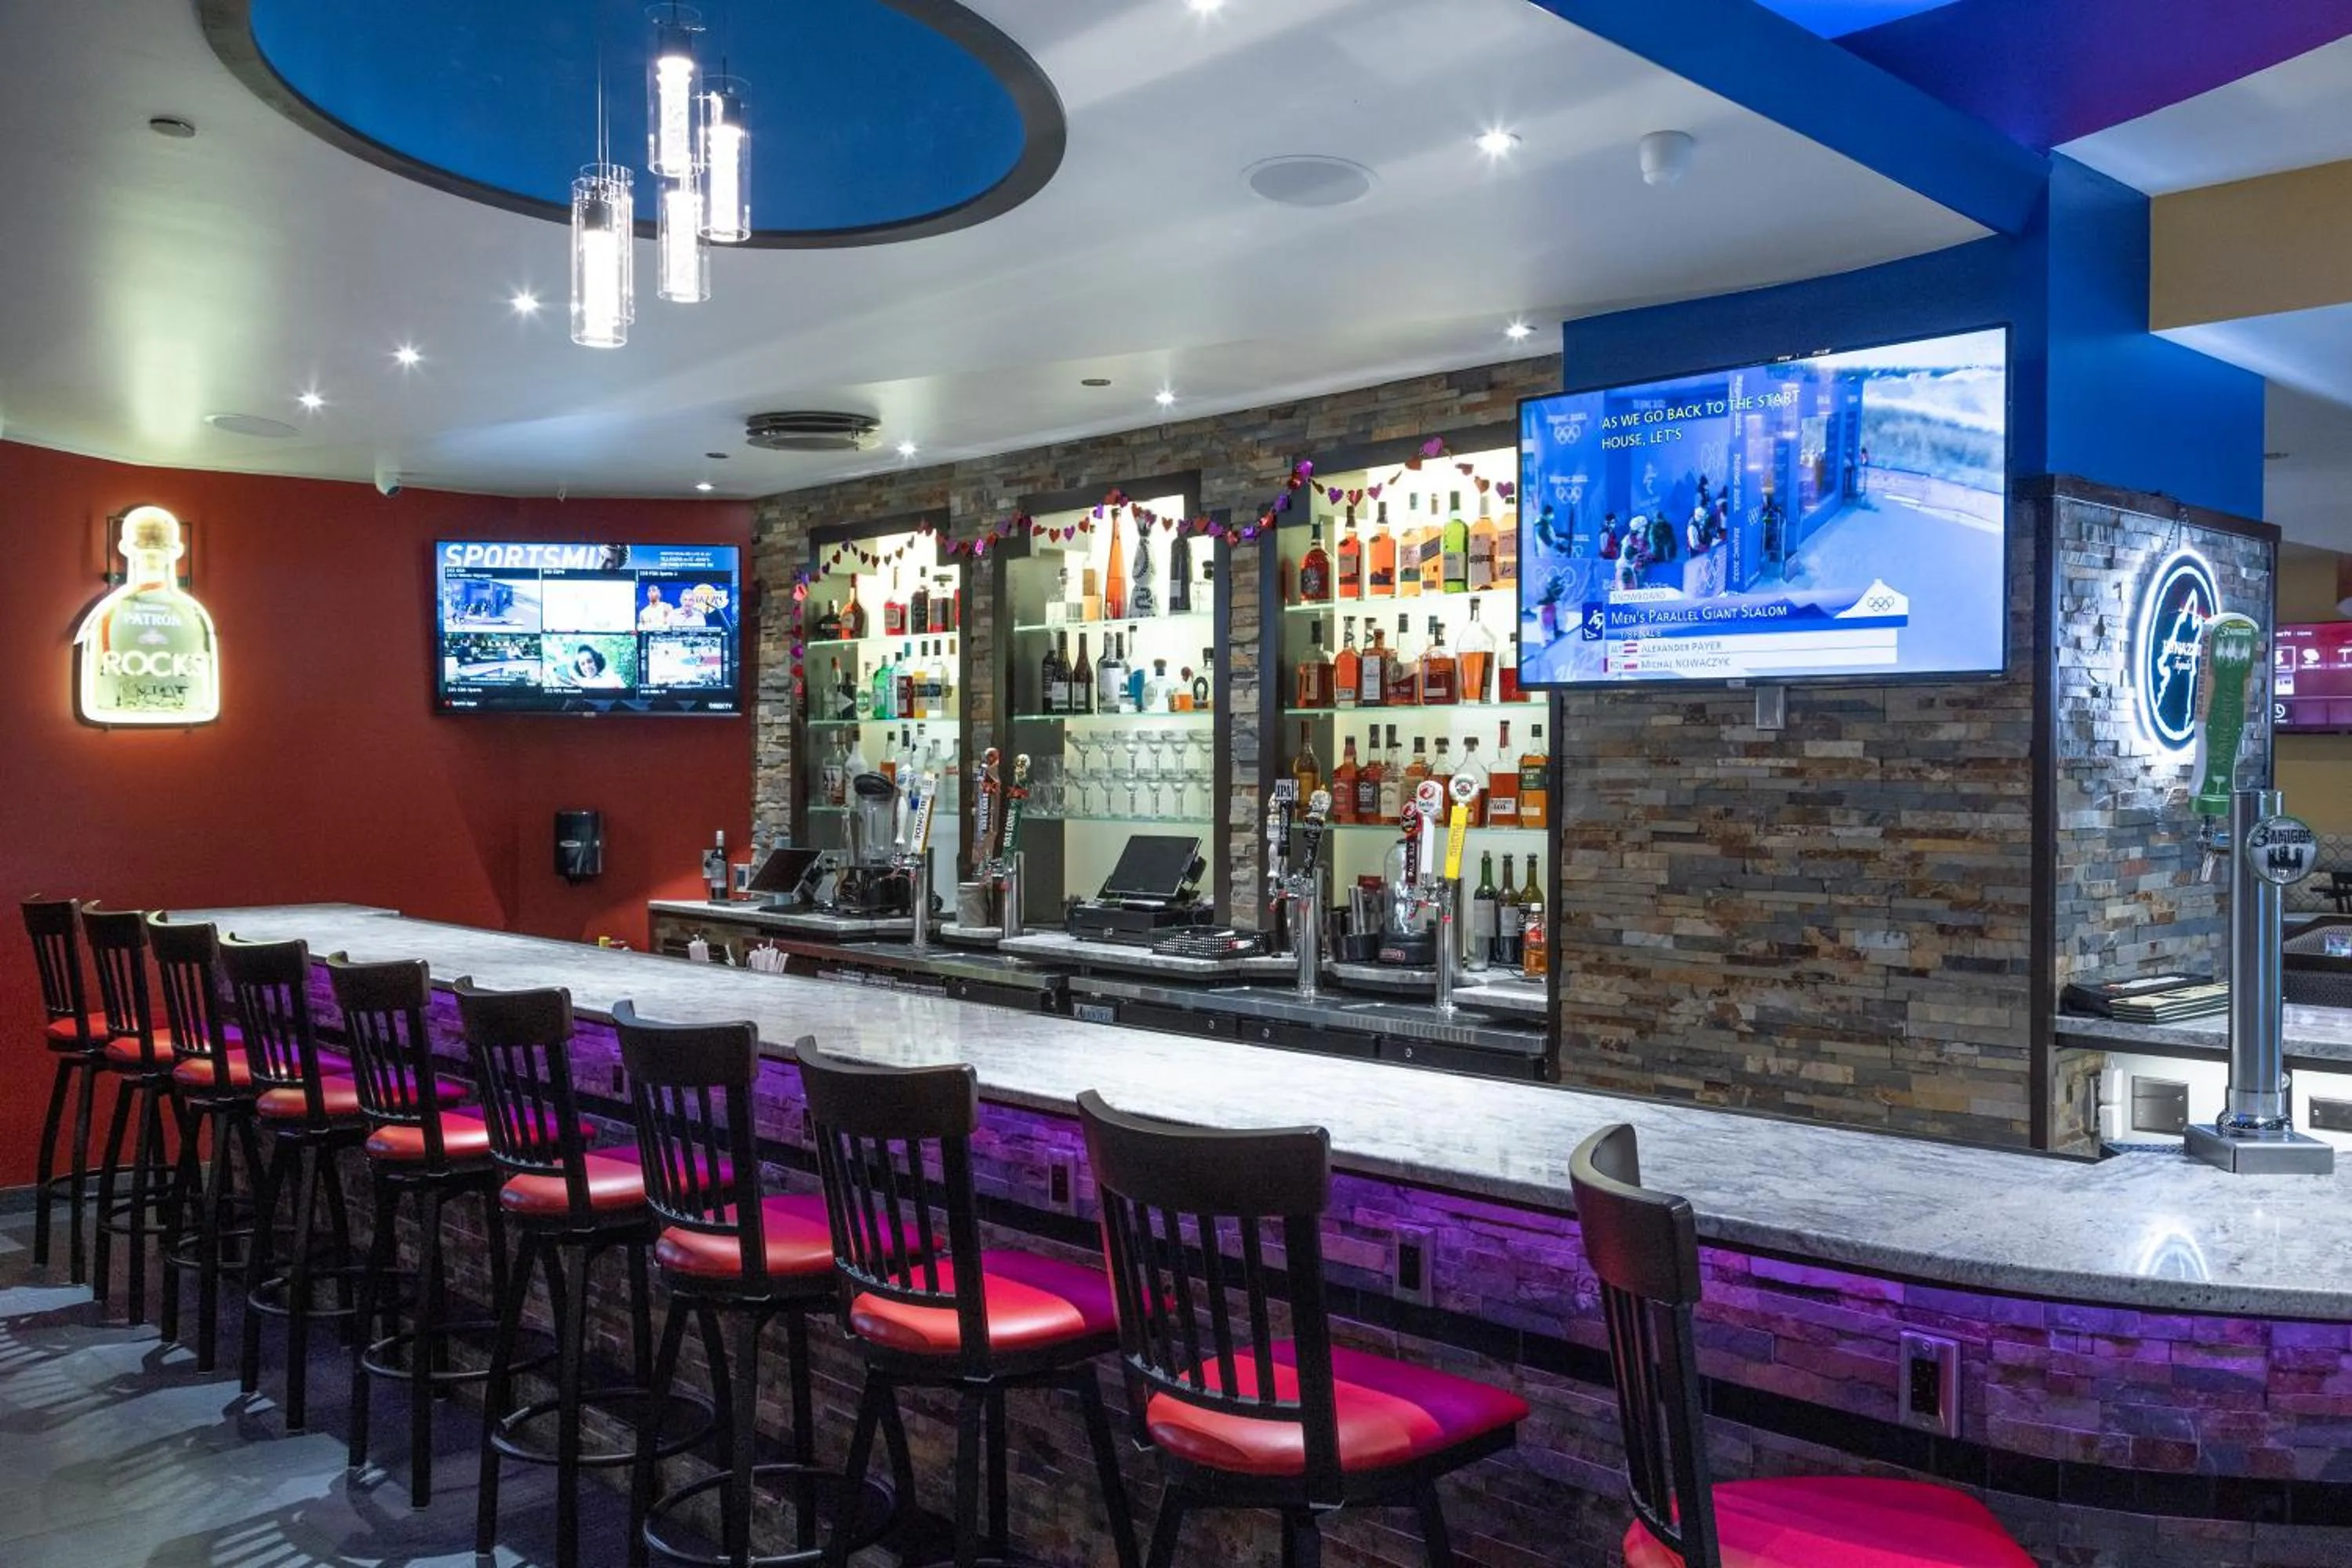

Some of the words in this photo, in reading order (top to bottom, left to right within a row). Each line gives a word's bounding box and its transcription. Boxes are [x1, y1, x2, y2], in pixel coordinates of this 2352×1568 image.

[1602, 416, 1617, 430] AS
[1621, 413, 1640, 426] WE
[1644, 411, 1664, 423] GO
[1668, 404, 1701, 420] BACK
[1706, 401, 1724, 415] TO
[1729, 395, 1754, 412] THE
[1758, 390, 1800, 408] START
[1650, 428, 1682, 444] LET'S
[1277, 785, 1291, 797] IPA
